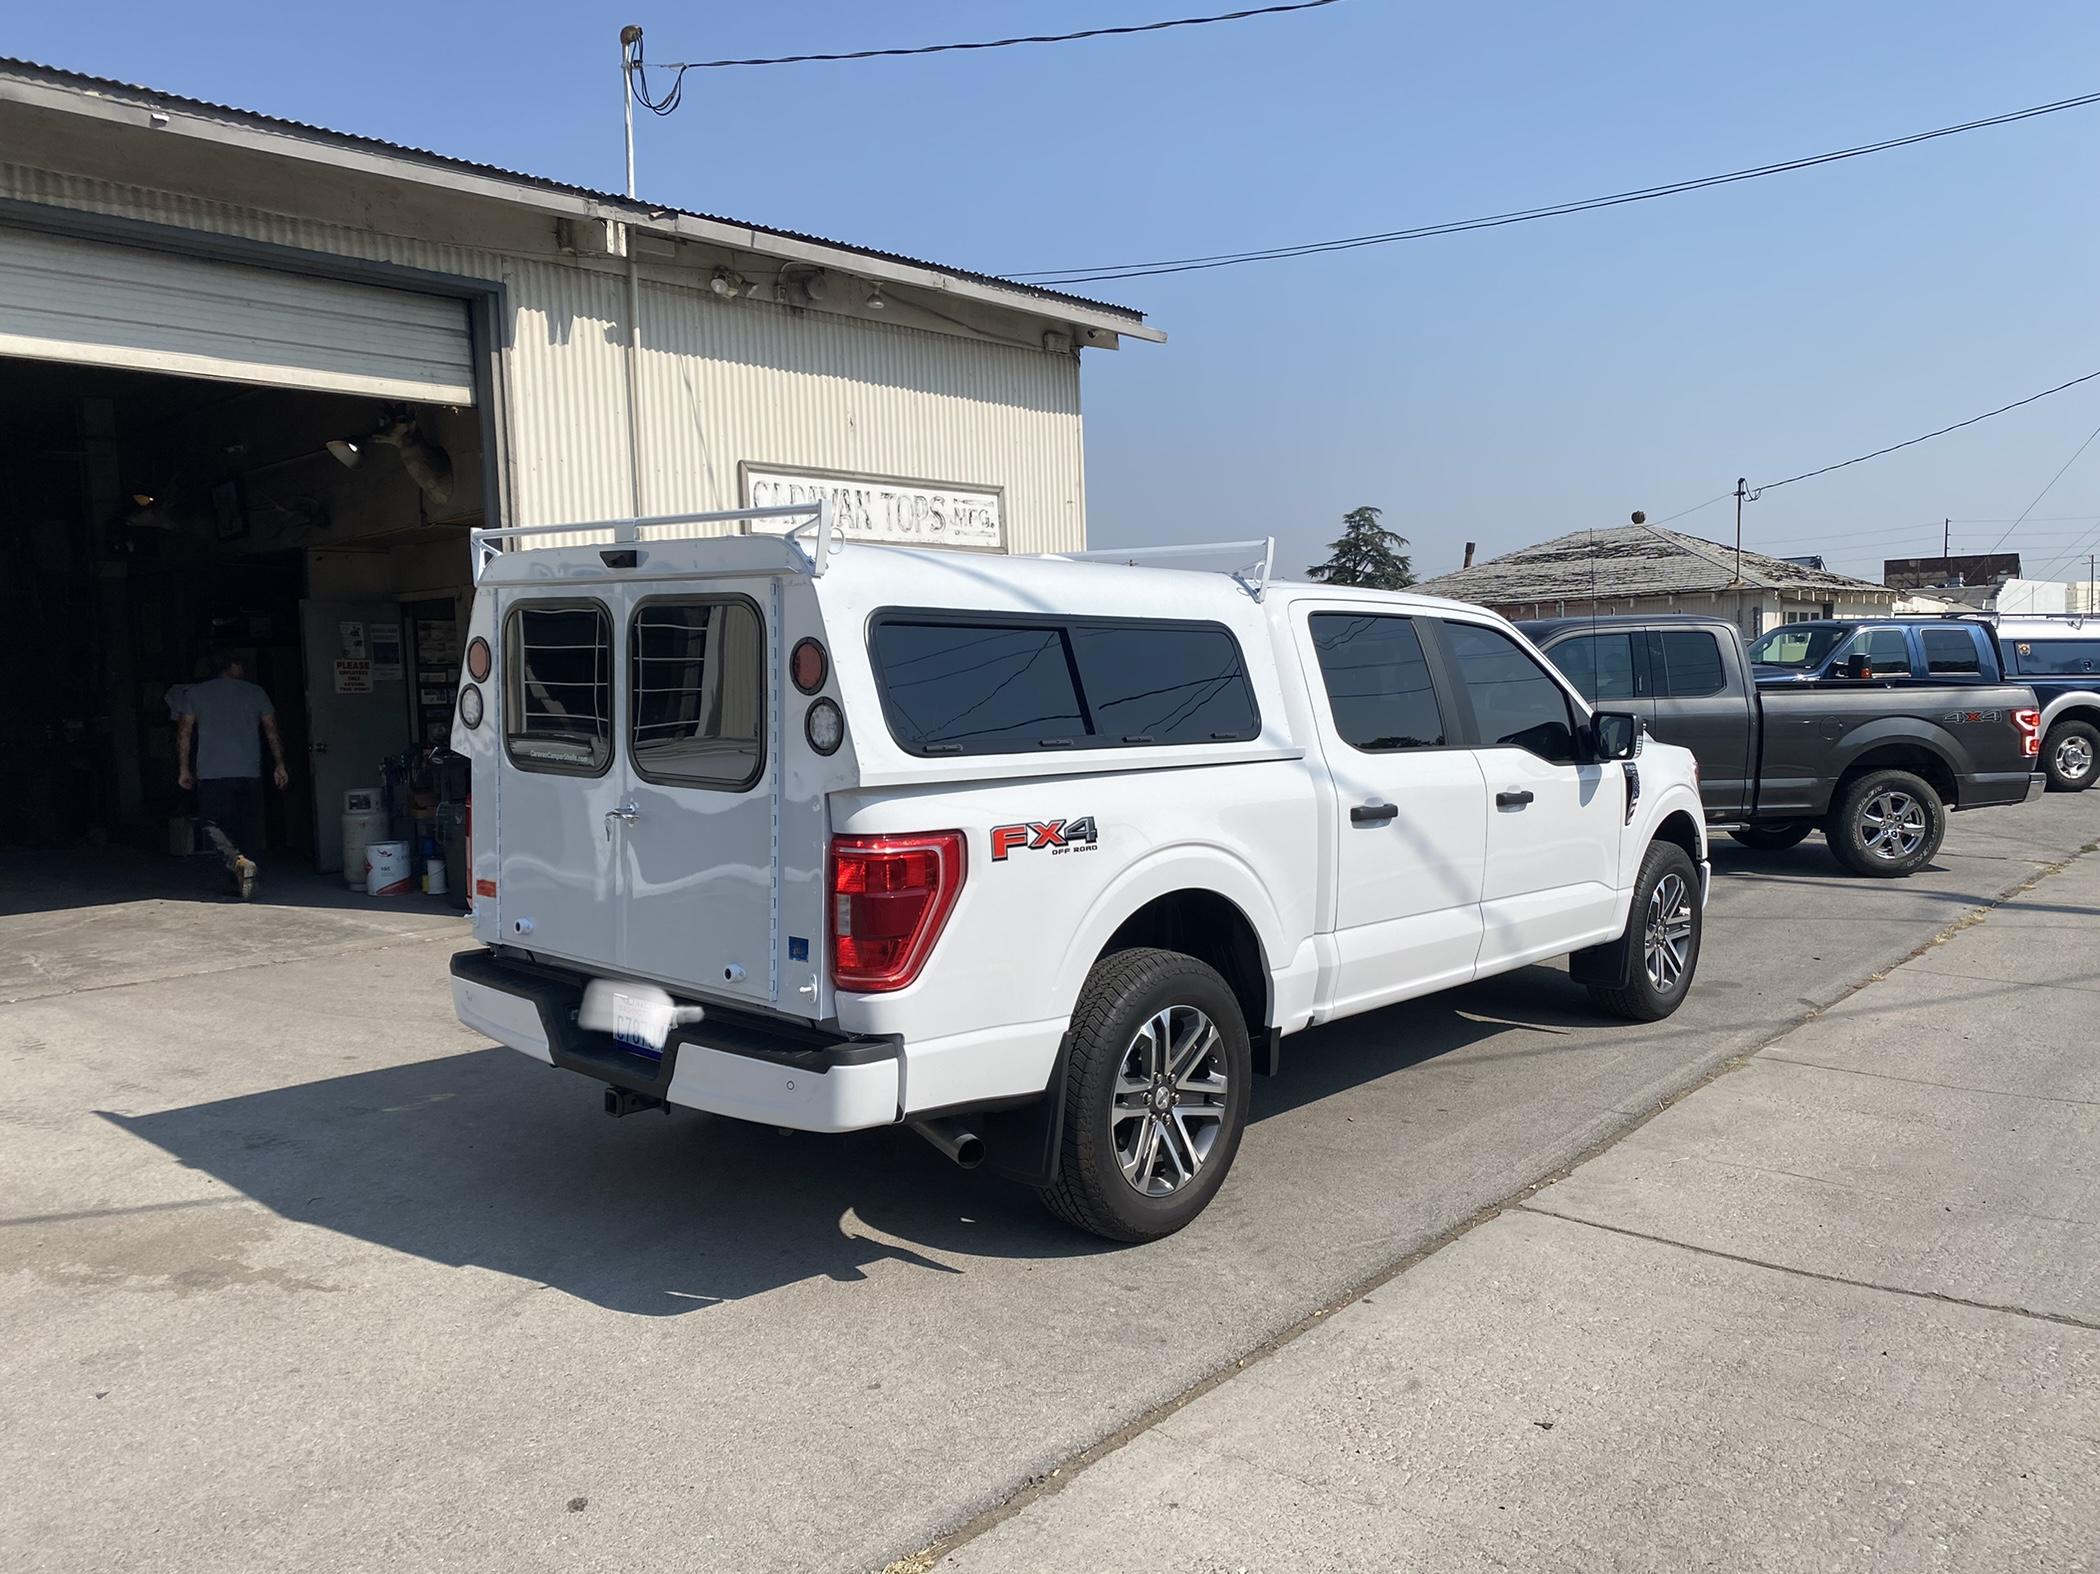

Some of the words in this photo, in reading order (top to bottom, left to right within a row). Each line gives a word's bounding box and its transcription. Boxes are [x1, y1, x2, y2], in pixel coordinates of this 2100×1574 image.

[880, 491, 946, 533] TOPS
[336, 661, 370, 670] PLEASE
[1943, 710, 2002, 724] 4X4
[990, 816, 1098, 862] FX4
